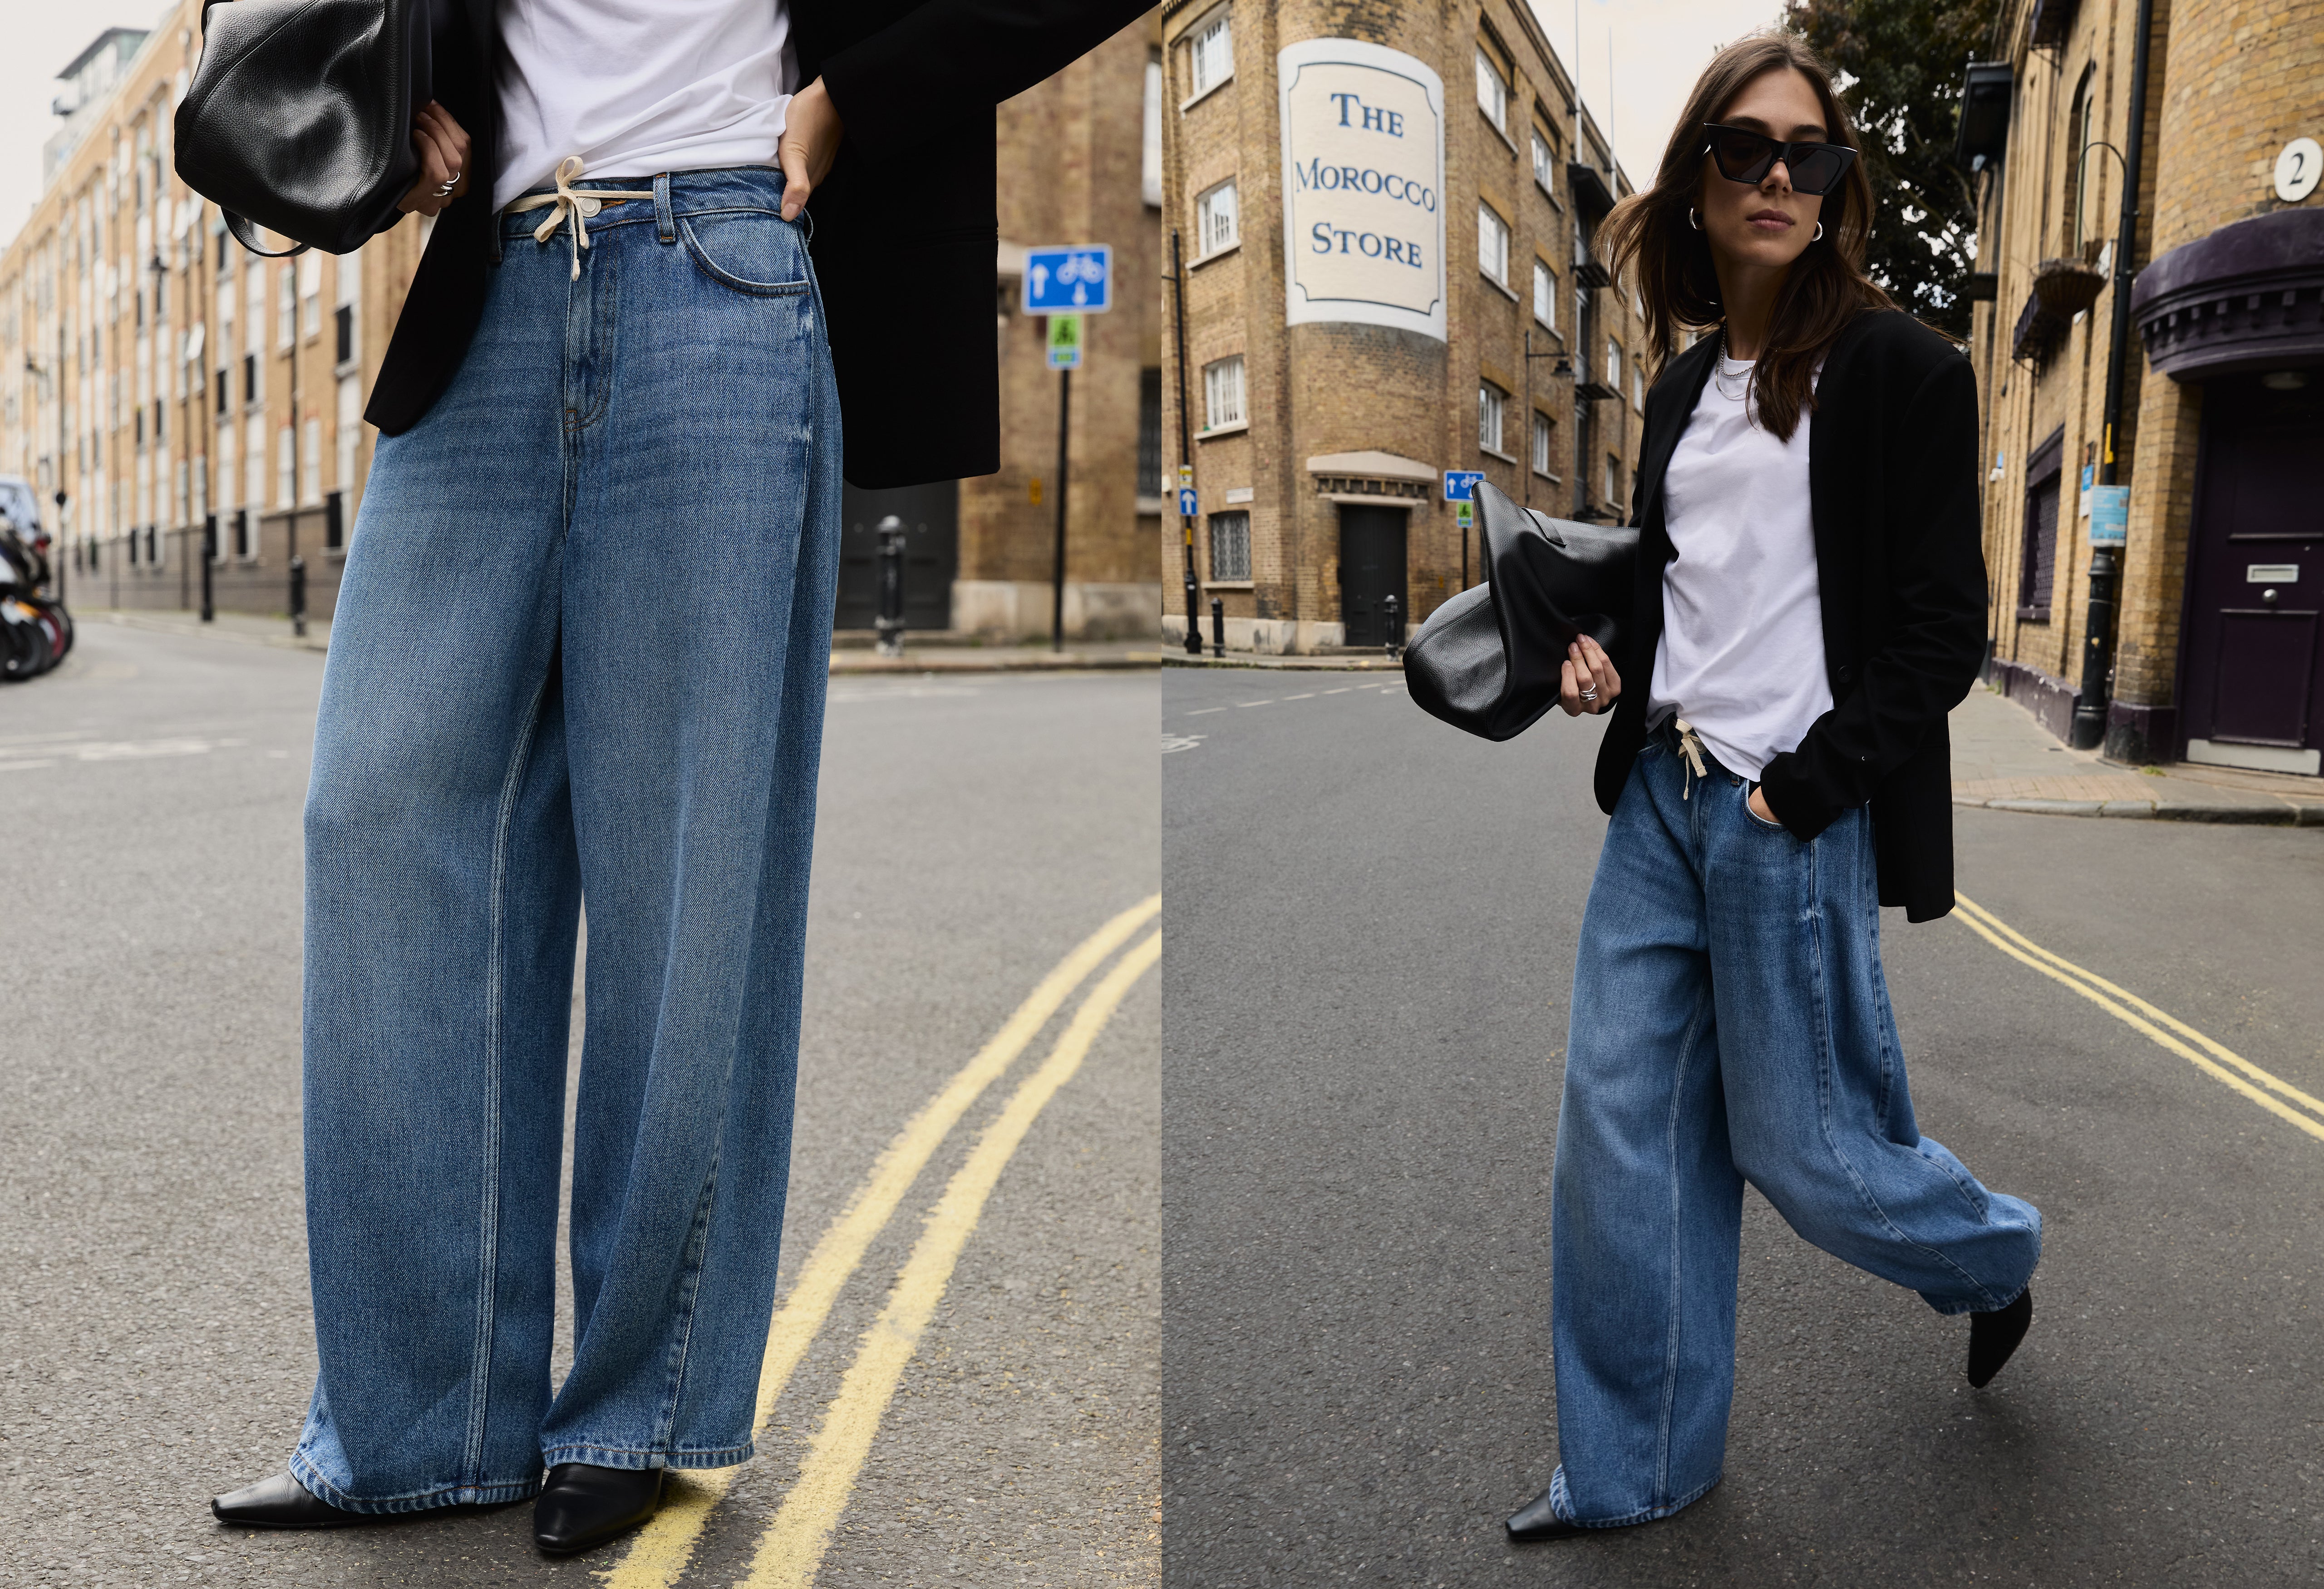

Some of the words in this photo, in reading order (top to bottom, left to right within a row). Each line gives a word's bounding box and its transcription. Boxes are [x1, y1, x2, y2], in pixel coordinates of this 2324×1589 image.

[1330, 93, 1404, 138] THE
[1296, 158, 1436, 213] MOROCCO
[2289, 153, 2304, 186] 2
[1312, 223, 1423, 269] STORE
